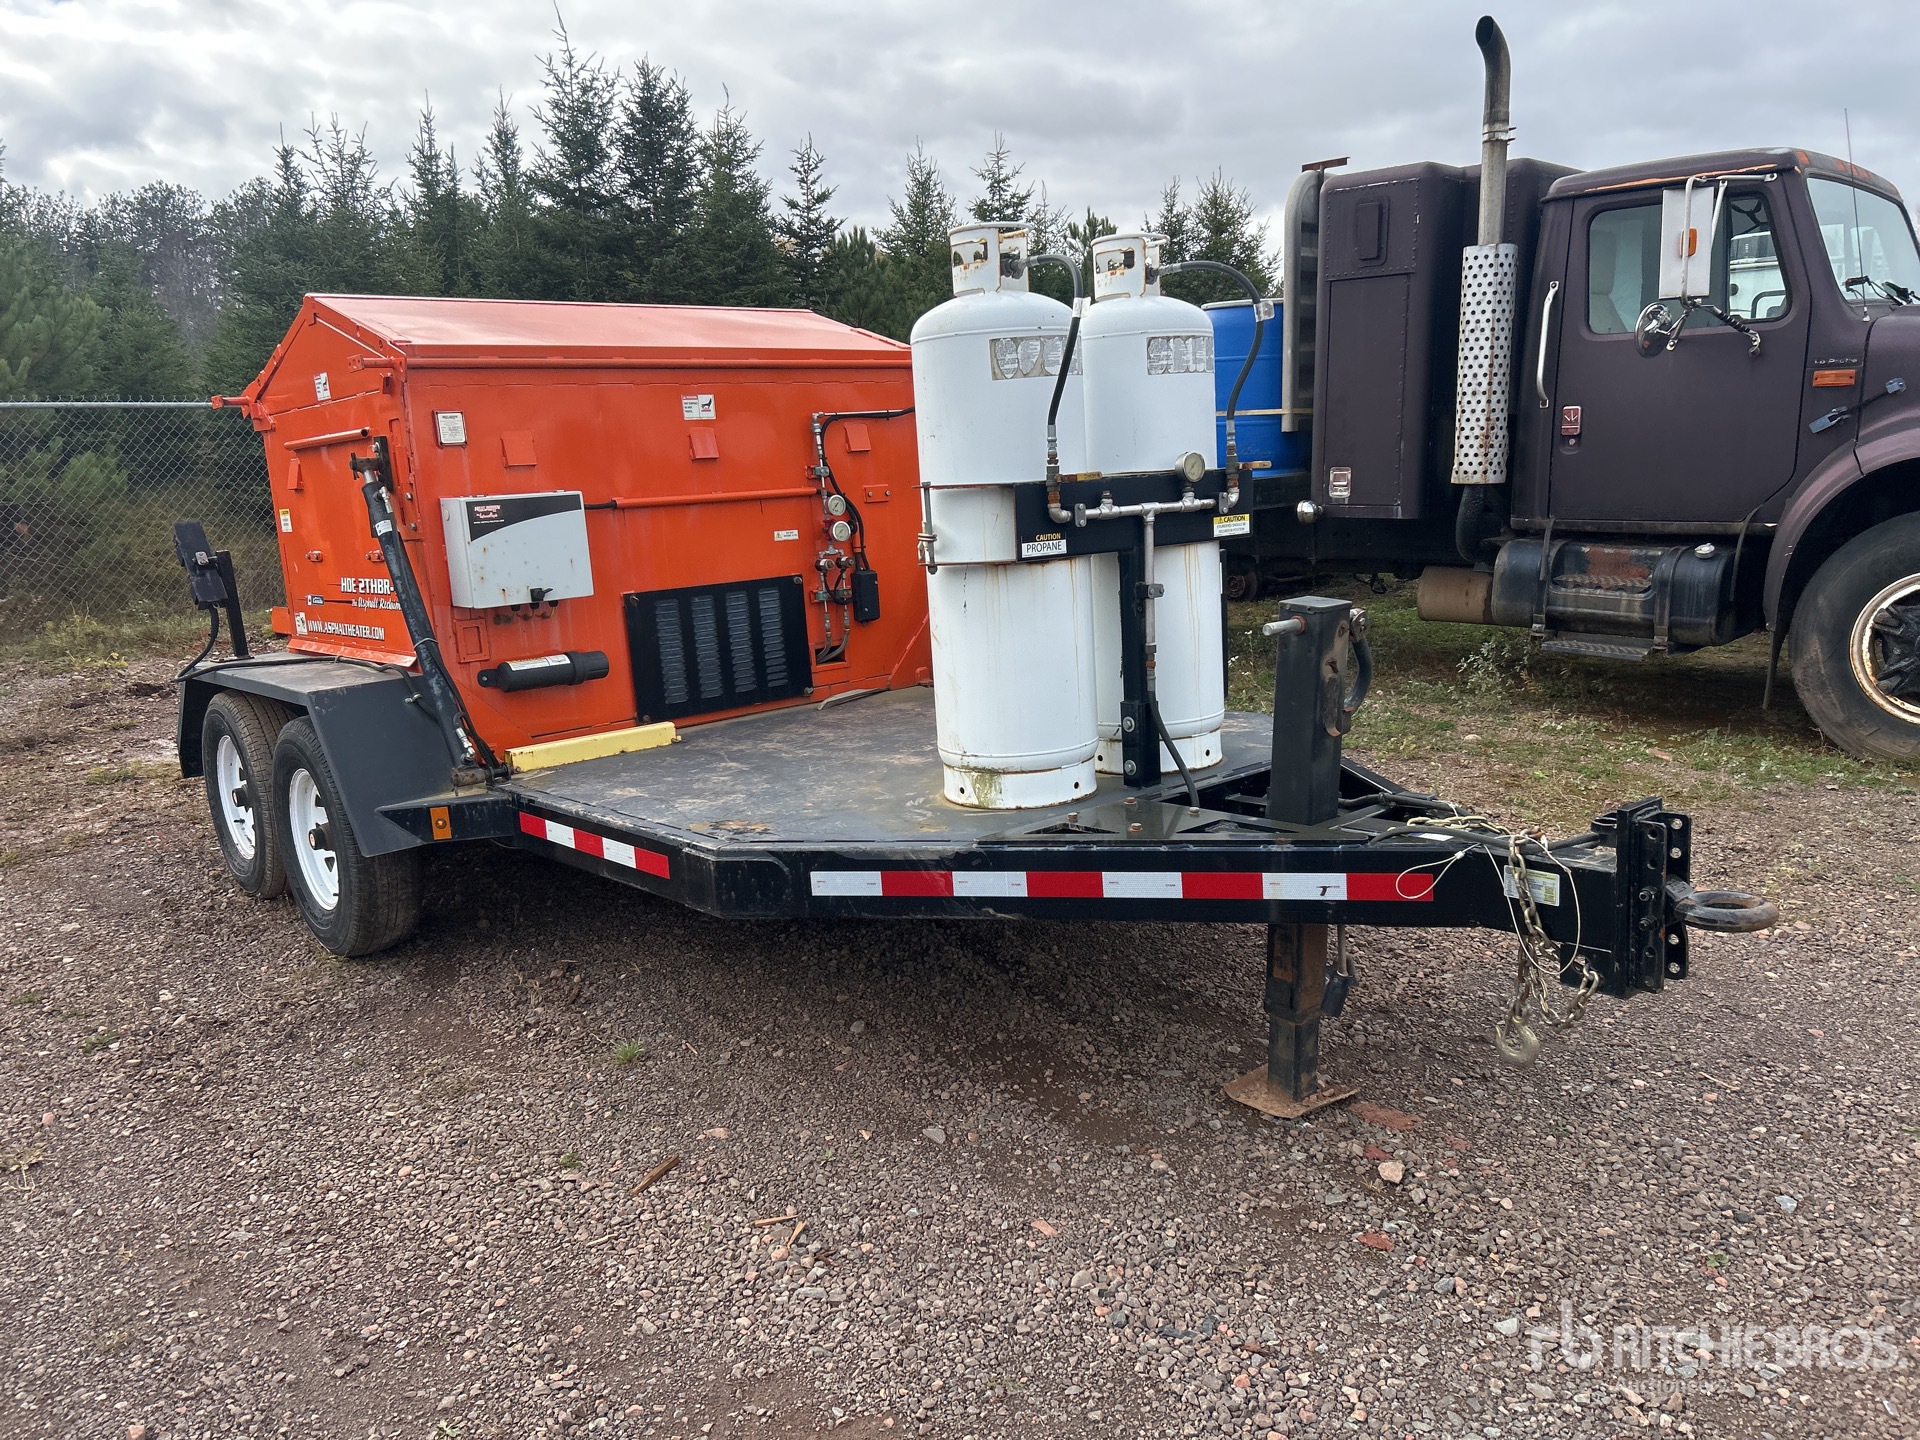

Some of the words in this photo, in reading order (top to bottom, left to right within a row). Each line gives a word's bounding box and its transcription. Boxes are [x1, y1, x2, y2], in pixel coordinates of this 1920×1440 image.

[1223, 515, 1246, 523] CAUTION
[1035, 532, 1061, 541] CAUTION
[1026, 541, 1062, 554] PROPANE
[340, 577, 357, 593] HDE
[358, 577, 395, 595] 2THBR-
[357, 597, 378, 612] Asphalt
[379, 597, 402, 611] Reclaim
[307, 619, 385, 640] WWW.ASPHALTHEATER.COM
